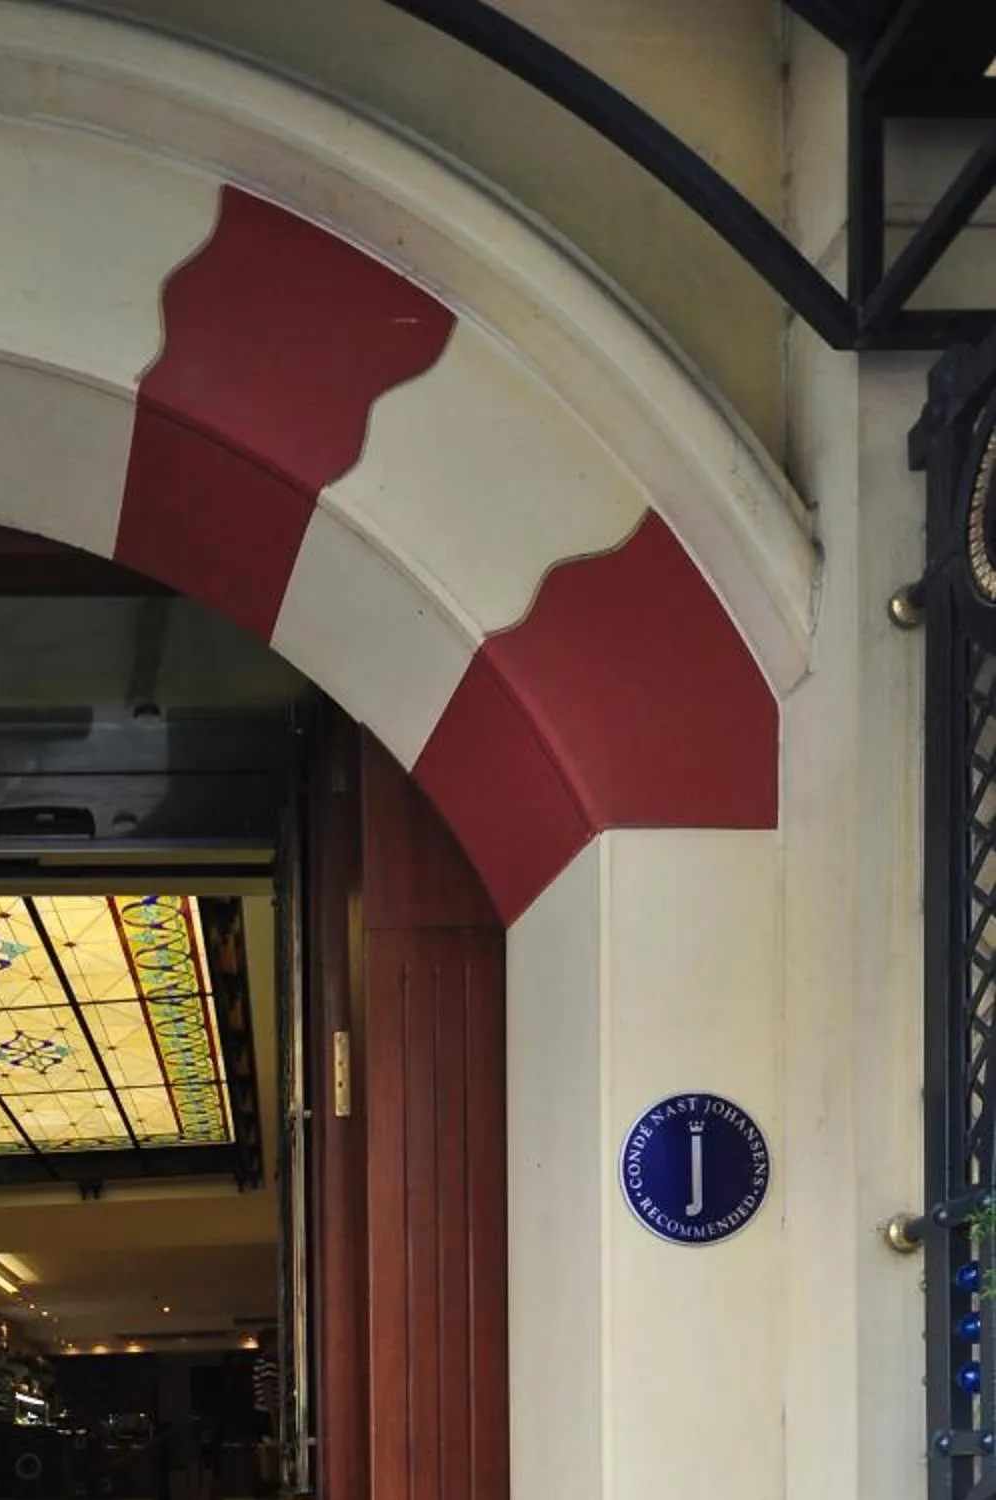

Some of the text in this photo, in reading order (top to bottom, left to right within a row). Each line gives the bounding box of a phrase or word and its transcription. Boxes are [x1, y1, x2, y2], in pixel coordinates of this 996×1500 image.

[651, 1097, 698, 1126] NAST
[703, 1099, 767, 1186] JOHANSENS
[639, 1195, 756, 1238] RECOMMENDED
